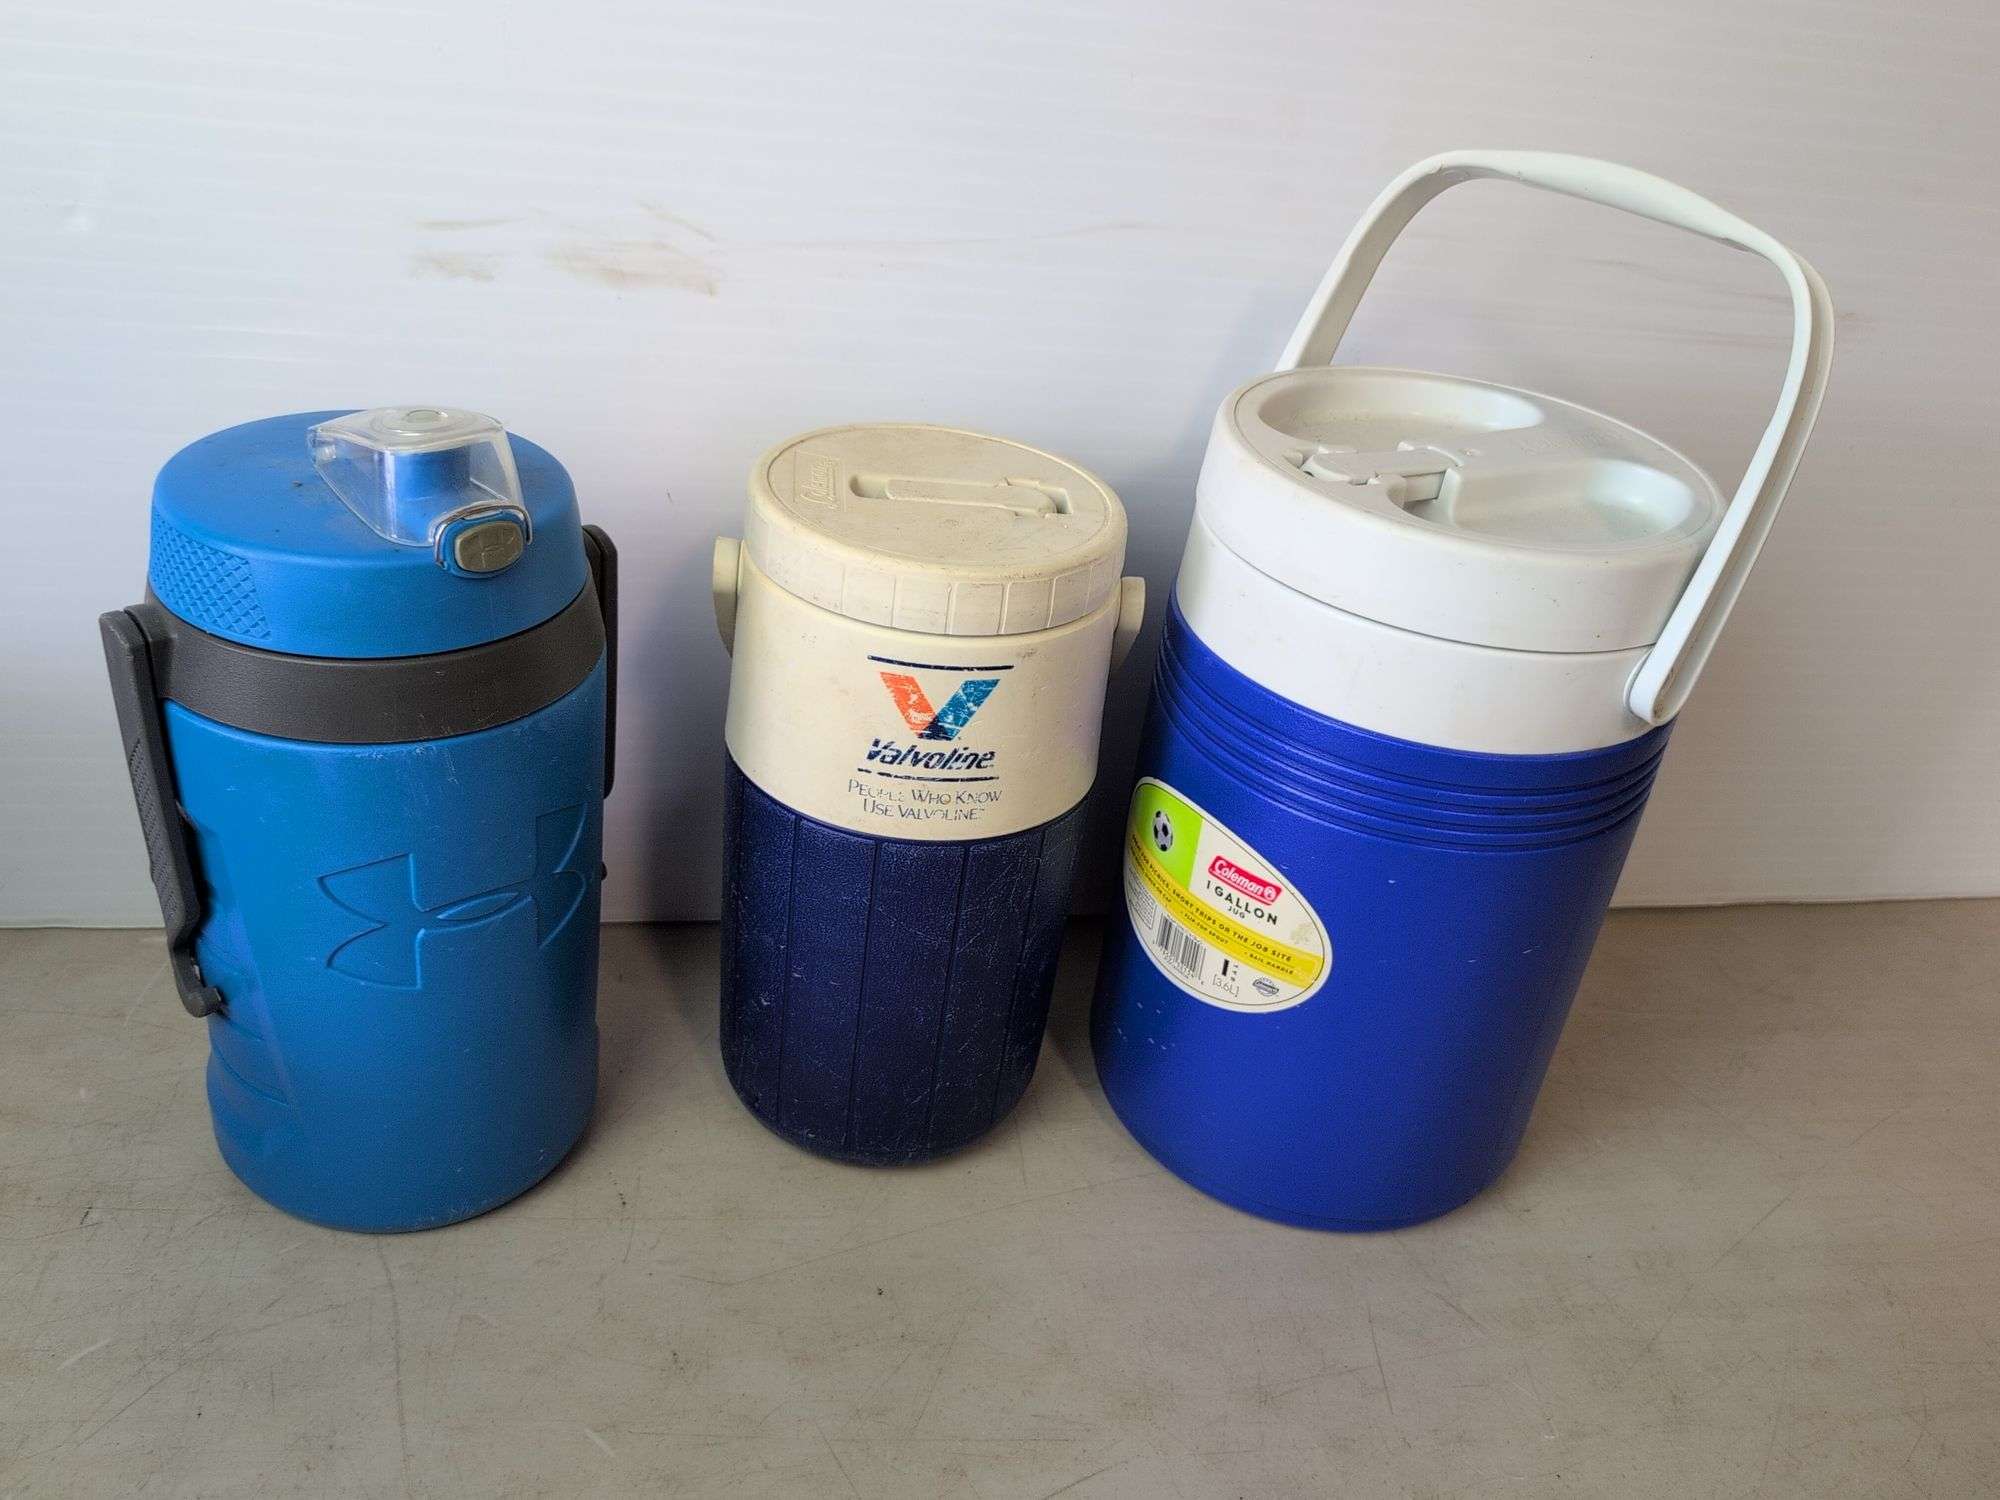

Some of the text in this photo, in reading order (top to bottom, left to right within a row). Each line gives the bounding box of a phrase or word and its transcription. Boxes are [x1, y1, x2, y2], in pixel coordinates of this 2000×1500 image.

[866, 737, 996, 770] Valvoline
[863, 798, 894, 817] USE
[912, 789, 952, 806] WHO
[955, 789, 1003, 804] KNOW
[1214, 859, 1265, 896] Coleman
[1214, 886, 1278, 926] GALLON
[1227, 905, 1246, 919] JUG
[1195, 907, 1216, 925] TRIPS
[1218, 923, 1230, 933] OR
[1232, 930, 1249, 943] THE
[1250, 939, 1269, 952] JOB
[1271, 949, 1293, 963] SITE
